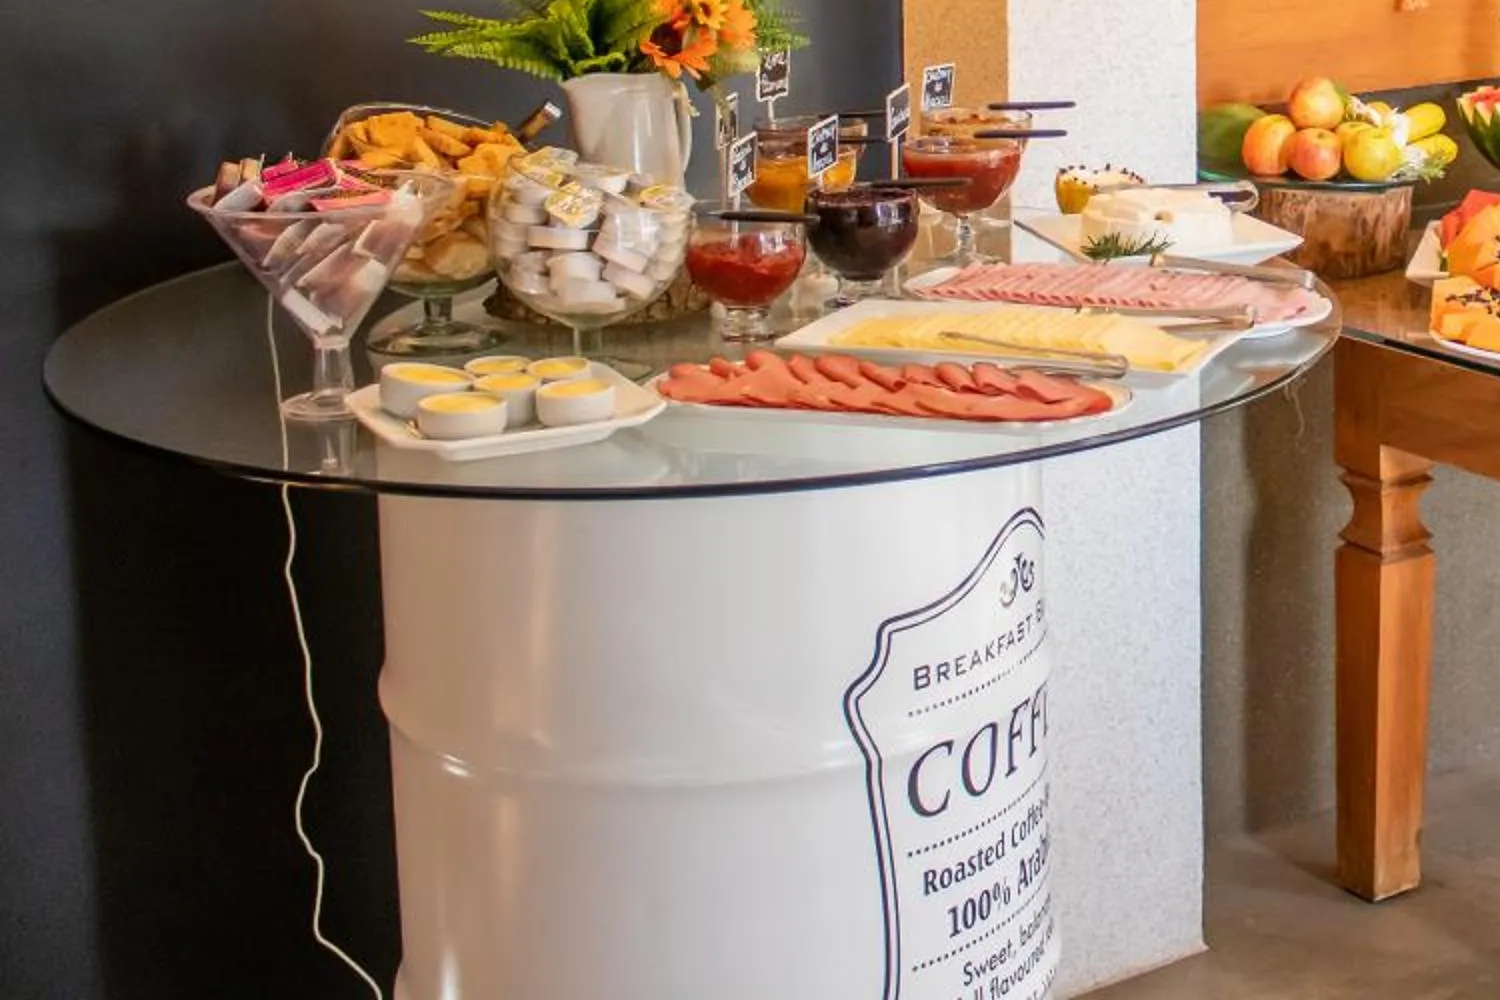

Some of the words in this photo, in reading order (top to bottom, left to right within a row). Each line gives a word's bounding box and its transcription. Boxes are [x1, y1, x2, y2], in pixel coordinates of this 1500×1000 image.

[914, 615, 1031, 690] BREAKFAST
[908, 679, 1048, 818] COFF
[923, 831, 1005, 896] Roasted
[947, 876, 1011, 938] 100%
[963, 939, 1016, 986] Sweet,
